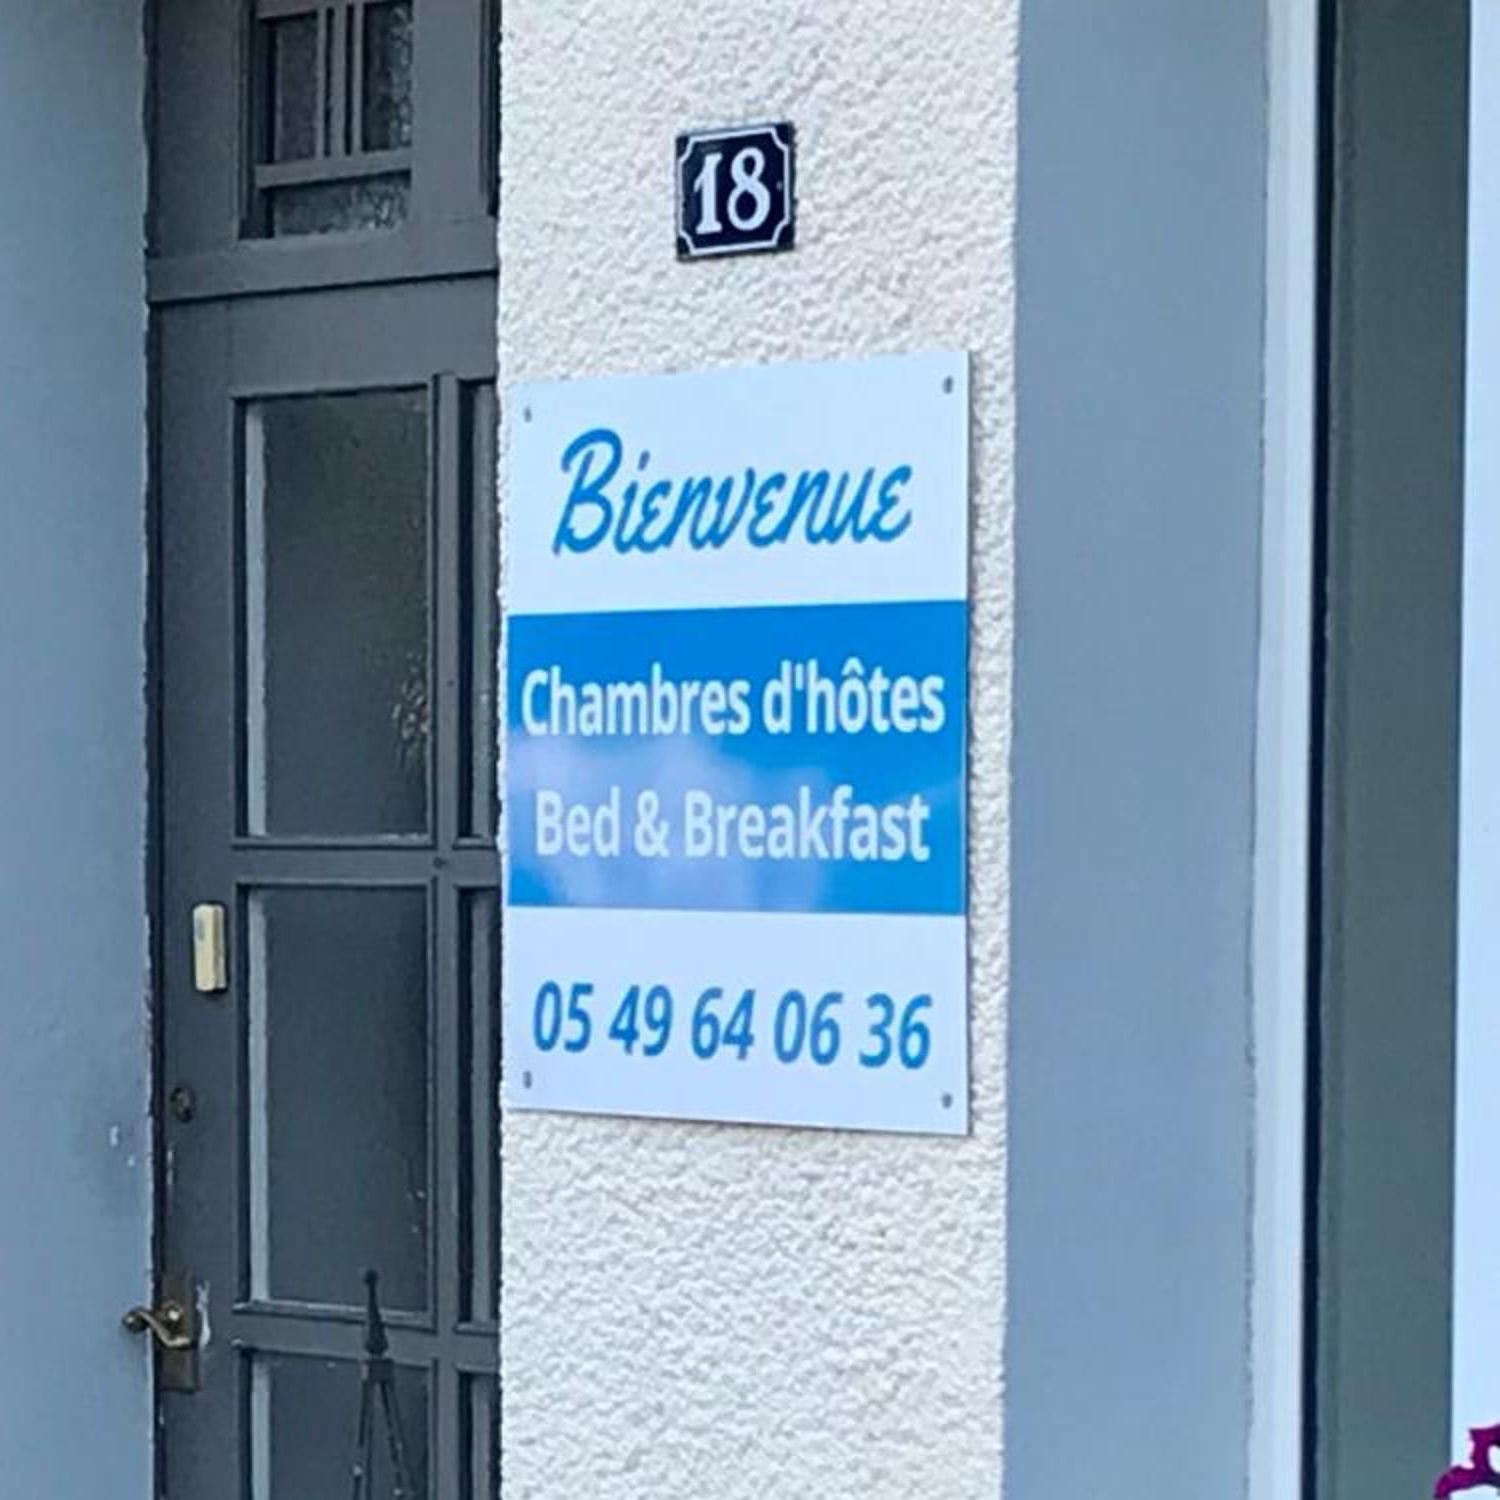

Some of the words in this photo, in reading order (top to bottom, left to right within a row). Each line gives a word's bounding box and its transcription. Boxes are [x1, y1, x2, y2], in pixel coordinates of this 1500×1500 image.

[693, 147, 771, 235] 18
[552, 427, 913, 556] Bienvenue
[521, 664, 750, 737] Chambres
[763, 658, 945, 733] d'hôtes
[536, 786, 621, 857] Bed
[634, 789, 669, 858] &
[684, 786, 929, 862] Breakfast
[532, 979, 595, 1054] 05
[607, 984, 675, 1058] 49
[690, 986, 757, 1062] 64
[773, 989, 845, 1067] 06
[858, 991, 933, 1071] 36
